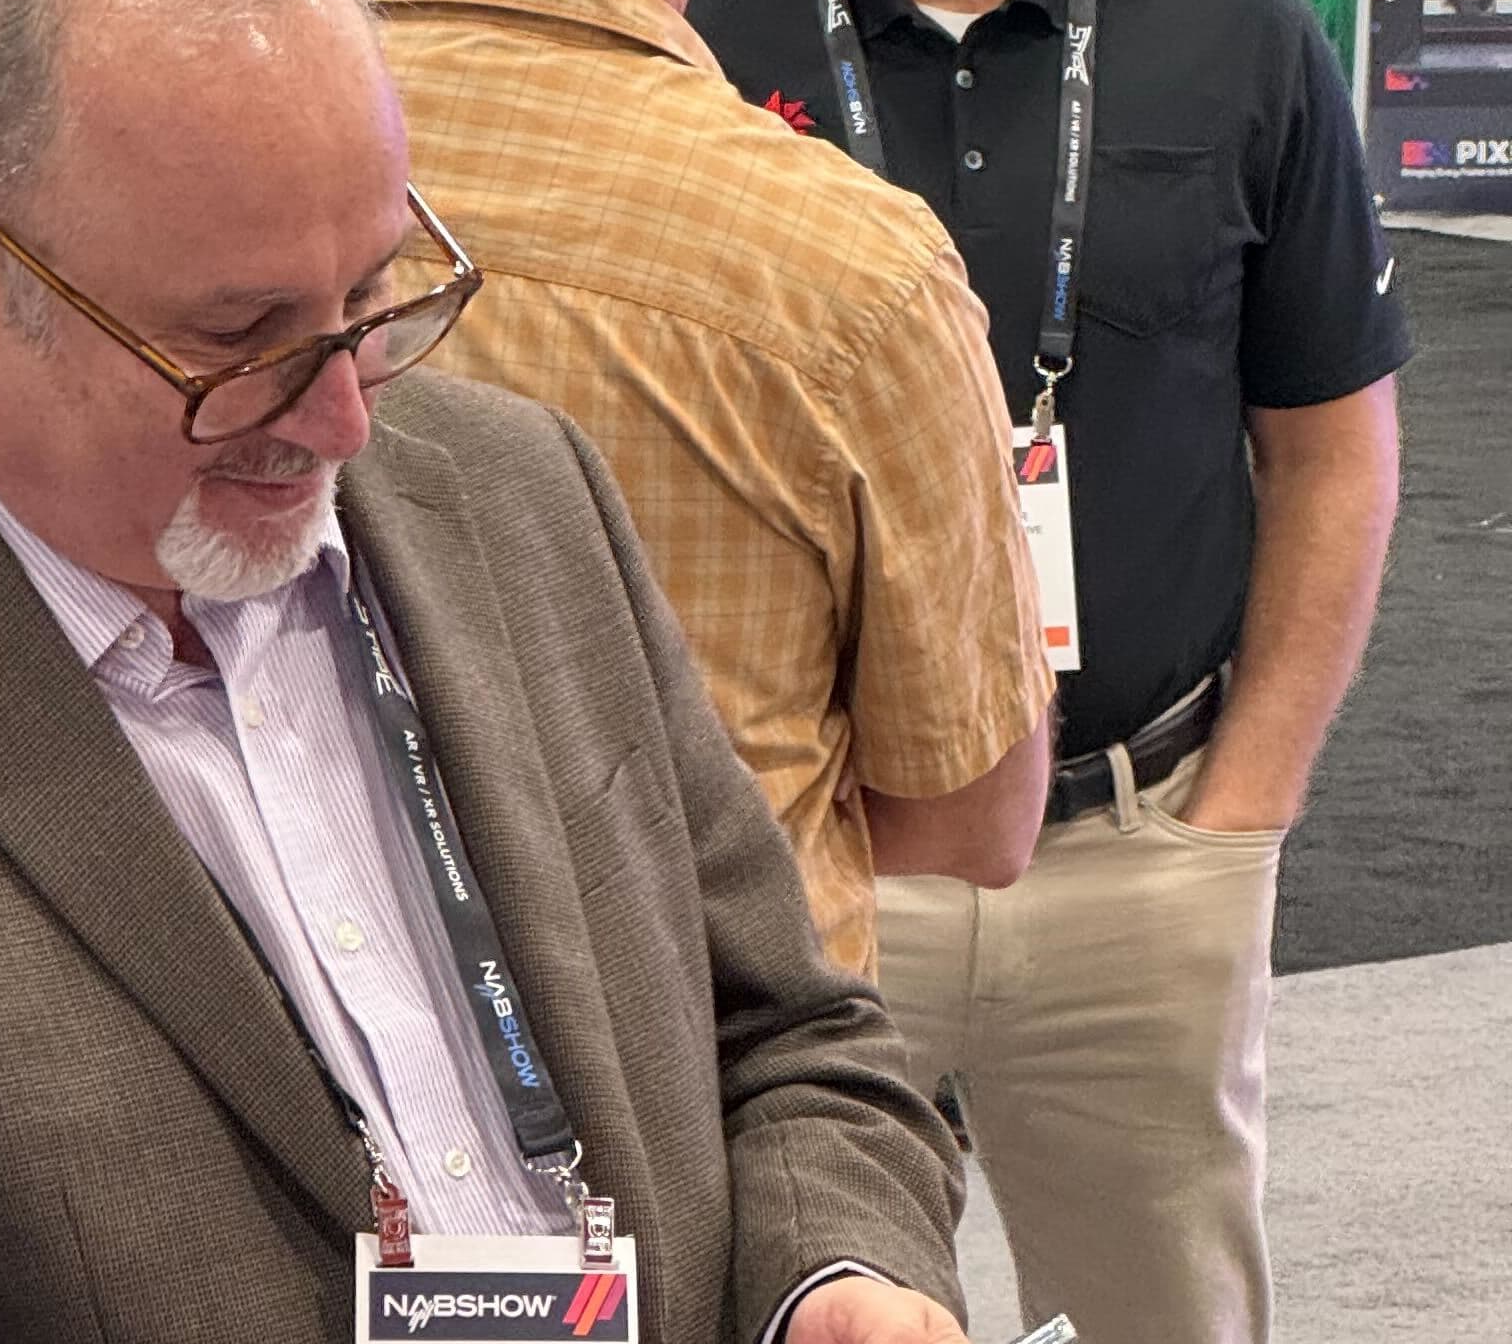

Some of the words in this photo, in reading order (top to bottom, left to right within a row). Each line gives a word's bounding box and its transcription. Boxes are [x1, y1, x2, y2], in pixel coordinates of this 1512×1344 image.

[1457, 140, 1512, 165] PIX
[403, 729, 418, 752] AR
[412, 764, 427, 785] VR
[421, 797, 438, 819] XR
[429, 821, 469, 902] SOLUTIONS
[477, 960, 541, 1088] NABSHOW
[383, 1294, 552, 1325] NABSHOW
